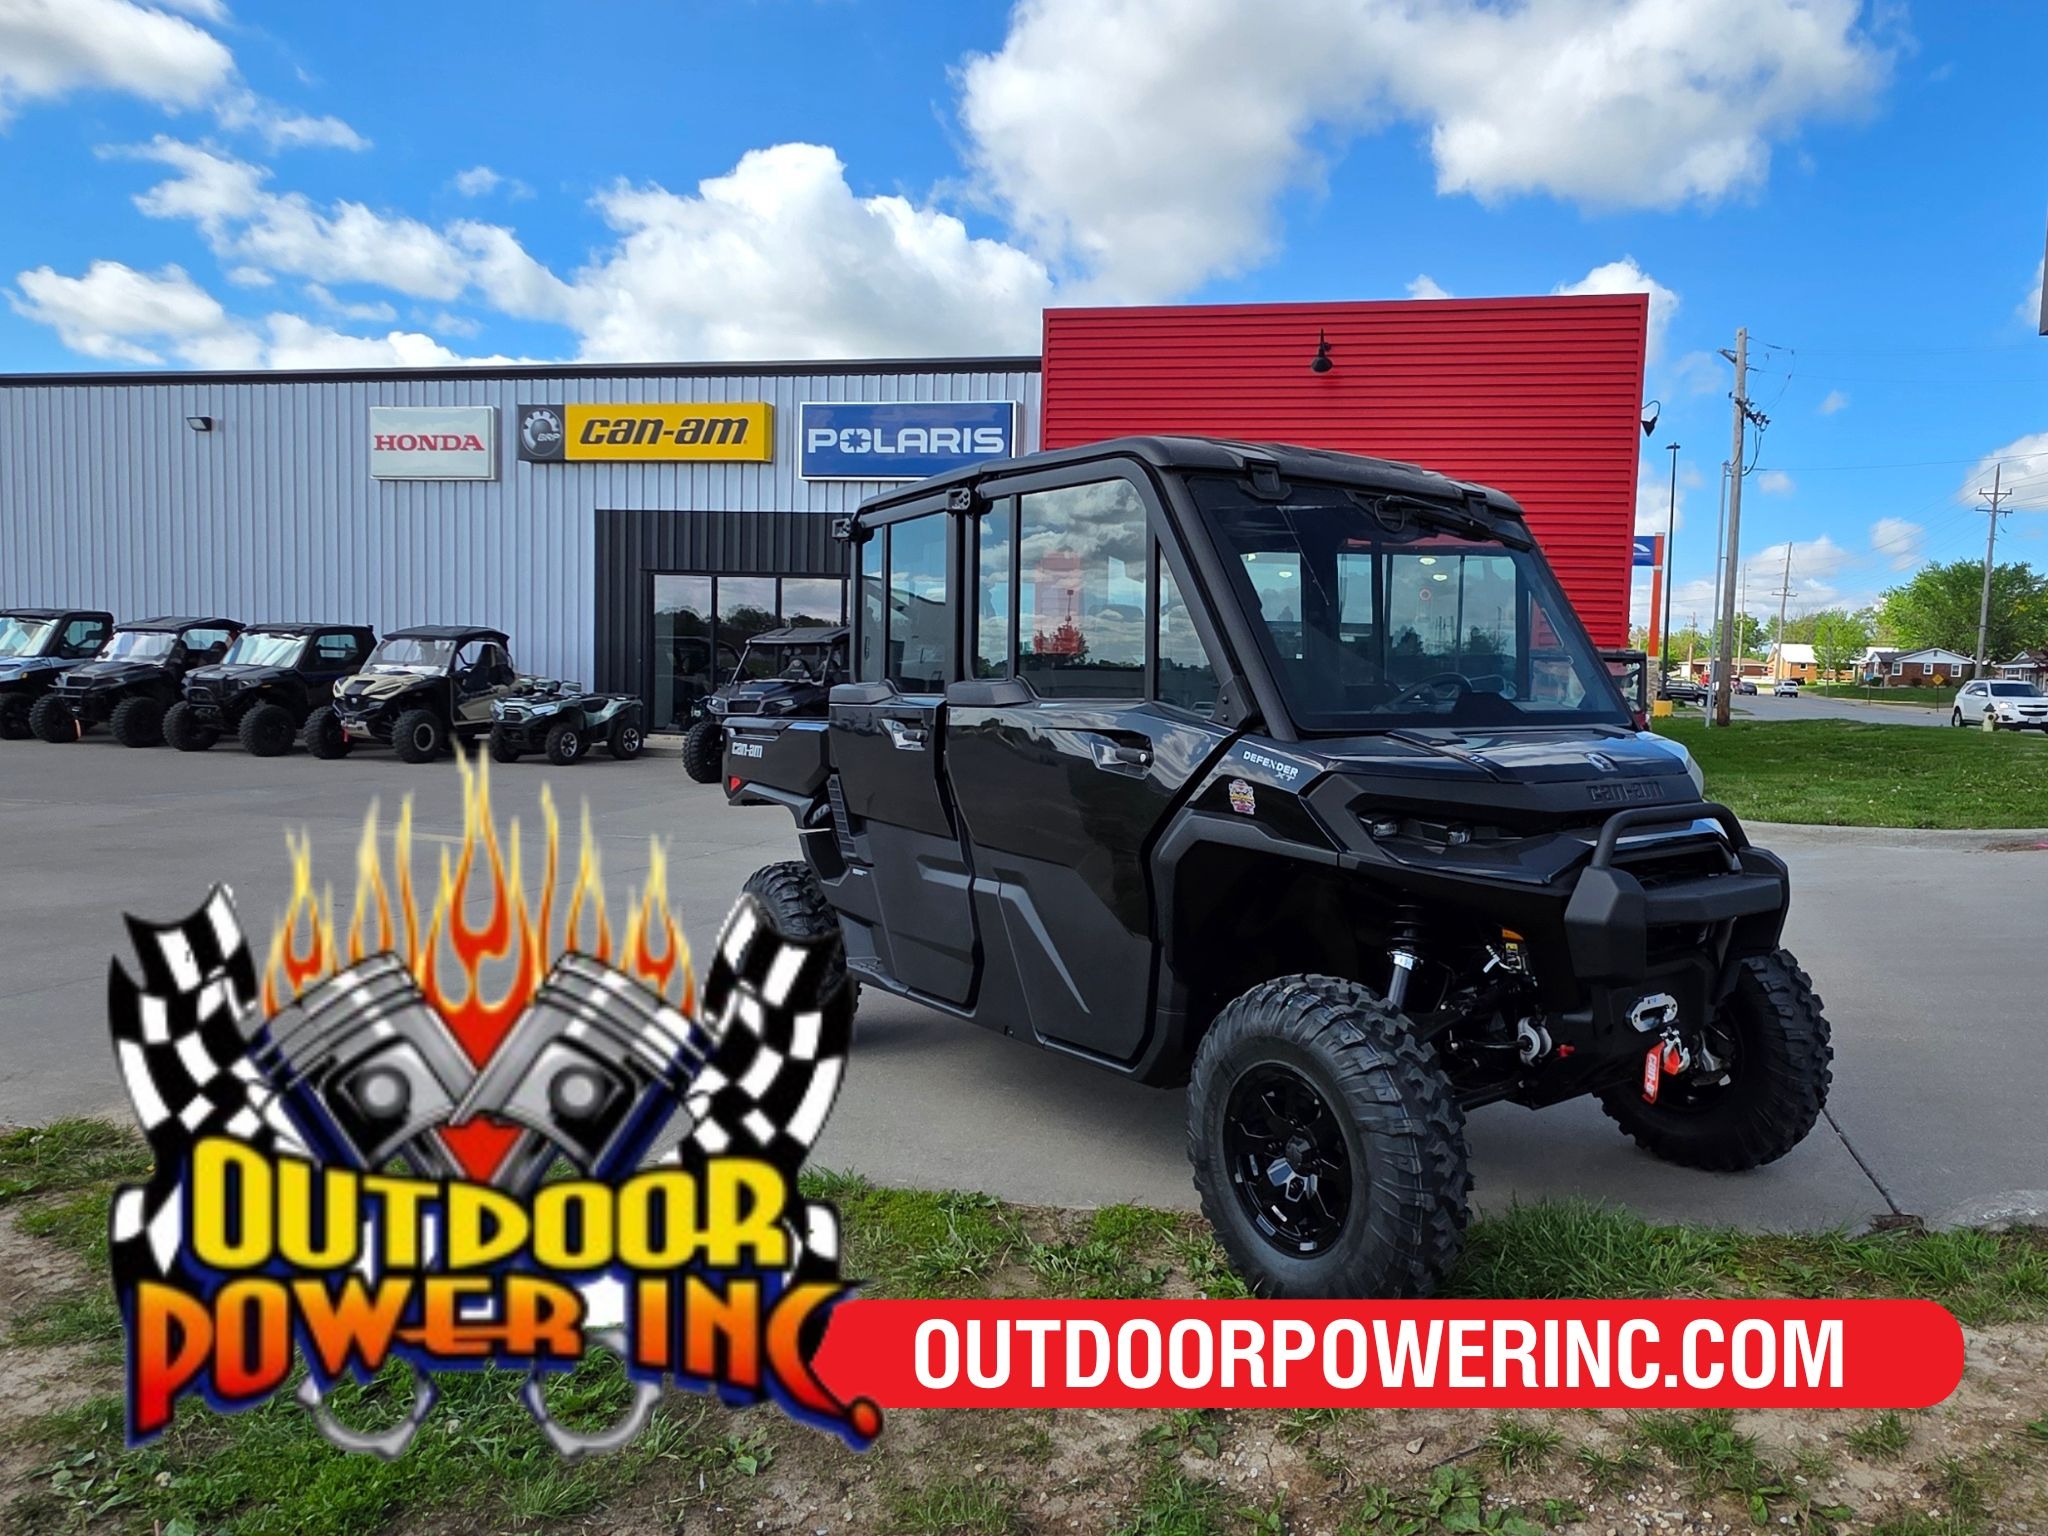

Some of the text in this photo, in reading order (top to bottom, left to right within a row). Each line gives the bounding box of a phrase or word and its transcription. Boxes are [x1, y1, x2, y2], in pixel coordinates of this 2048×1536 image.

[578, 417, 749, 445] can-am
[808, 427, 1005, 454] POLARIS
[373, 433, 486, 452] HONDA
[731, 741, 763, 759] can-am
[1243, 750, 1299, 776] DEFENDER
[1275, 772, 1296, 782] XT
